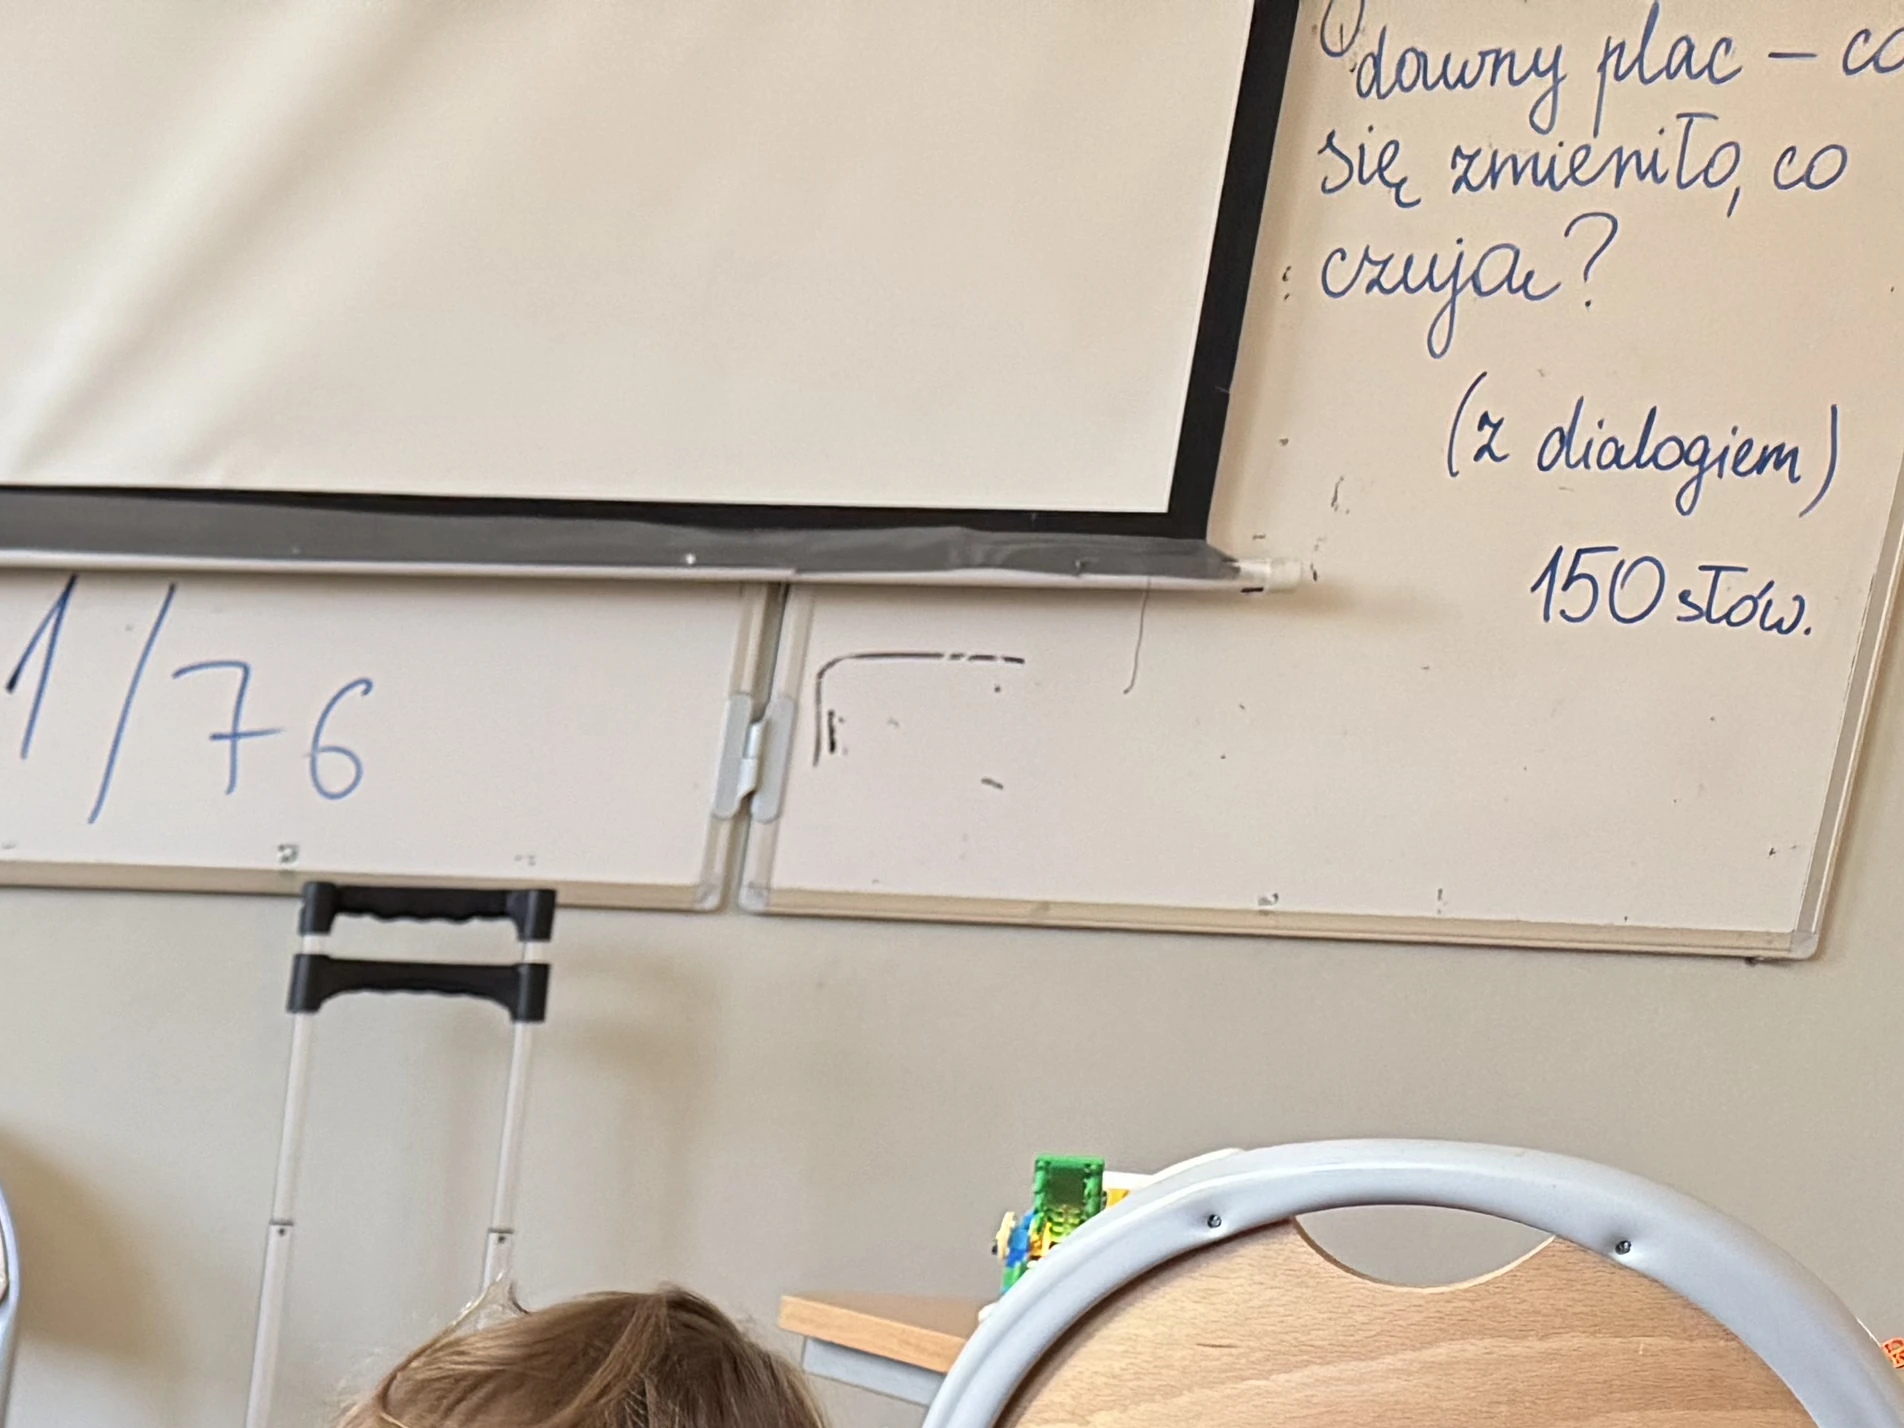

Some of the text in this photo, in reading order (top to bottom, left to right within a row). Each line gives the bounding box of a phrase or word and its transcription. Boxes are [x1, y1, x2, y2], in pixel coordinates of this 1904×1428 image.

[1355, 24, 1569, 137] dawny
[1593, 0, 1744, 139] plac
[1318, 112, 1849, 217] się zmieniło, co
[1446, 371, 1839, 518] (z dialogiem)
[1530, 545, 1666, 625] 150
[4, 573, 375, 824] 1/76
